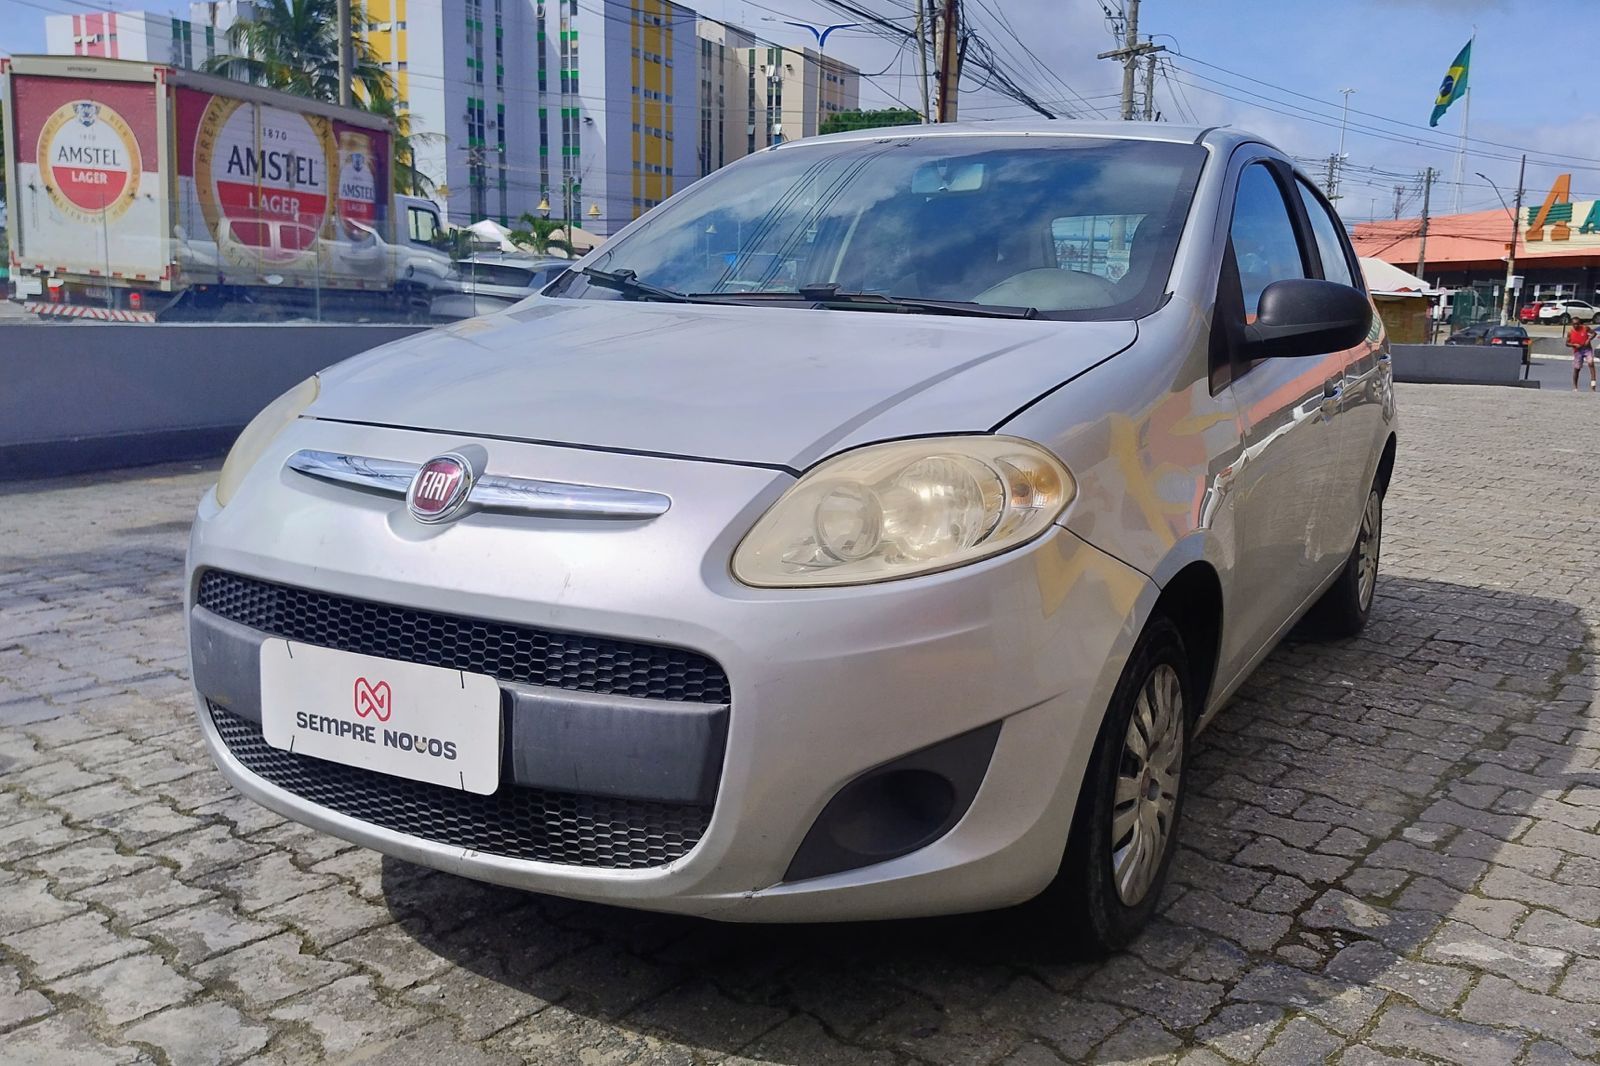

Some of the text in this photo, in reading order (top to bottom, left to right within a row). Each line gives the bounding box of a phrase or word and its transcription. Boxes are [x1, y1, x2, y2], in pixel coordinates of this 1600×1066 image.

[262, 127, 288, 141] 1870
[58, 145, 121, 166] AMSTEL
[227, 144, 319, 186] AMSTEL
[71, 170, 108, 184] LAGER
[342, 183, 374, 200] AMSTEL
[249, 192, 300, 214] LAGER
[418, 471, 457, 501] FIAT
[296, 711, 376, 744] SEMPRE
